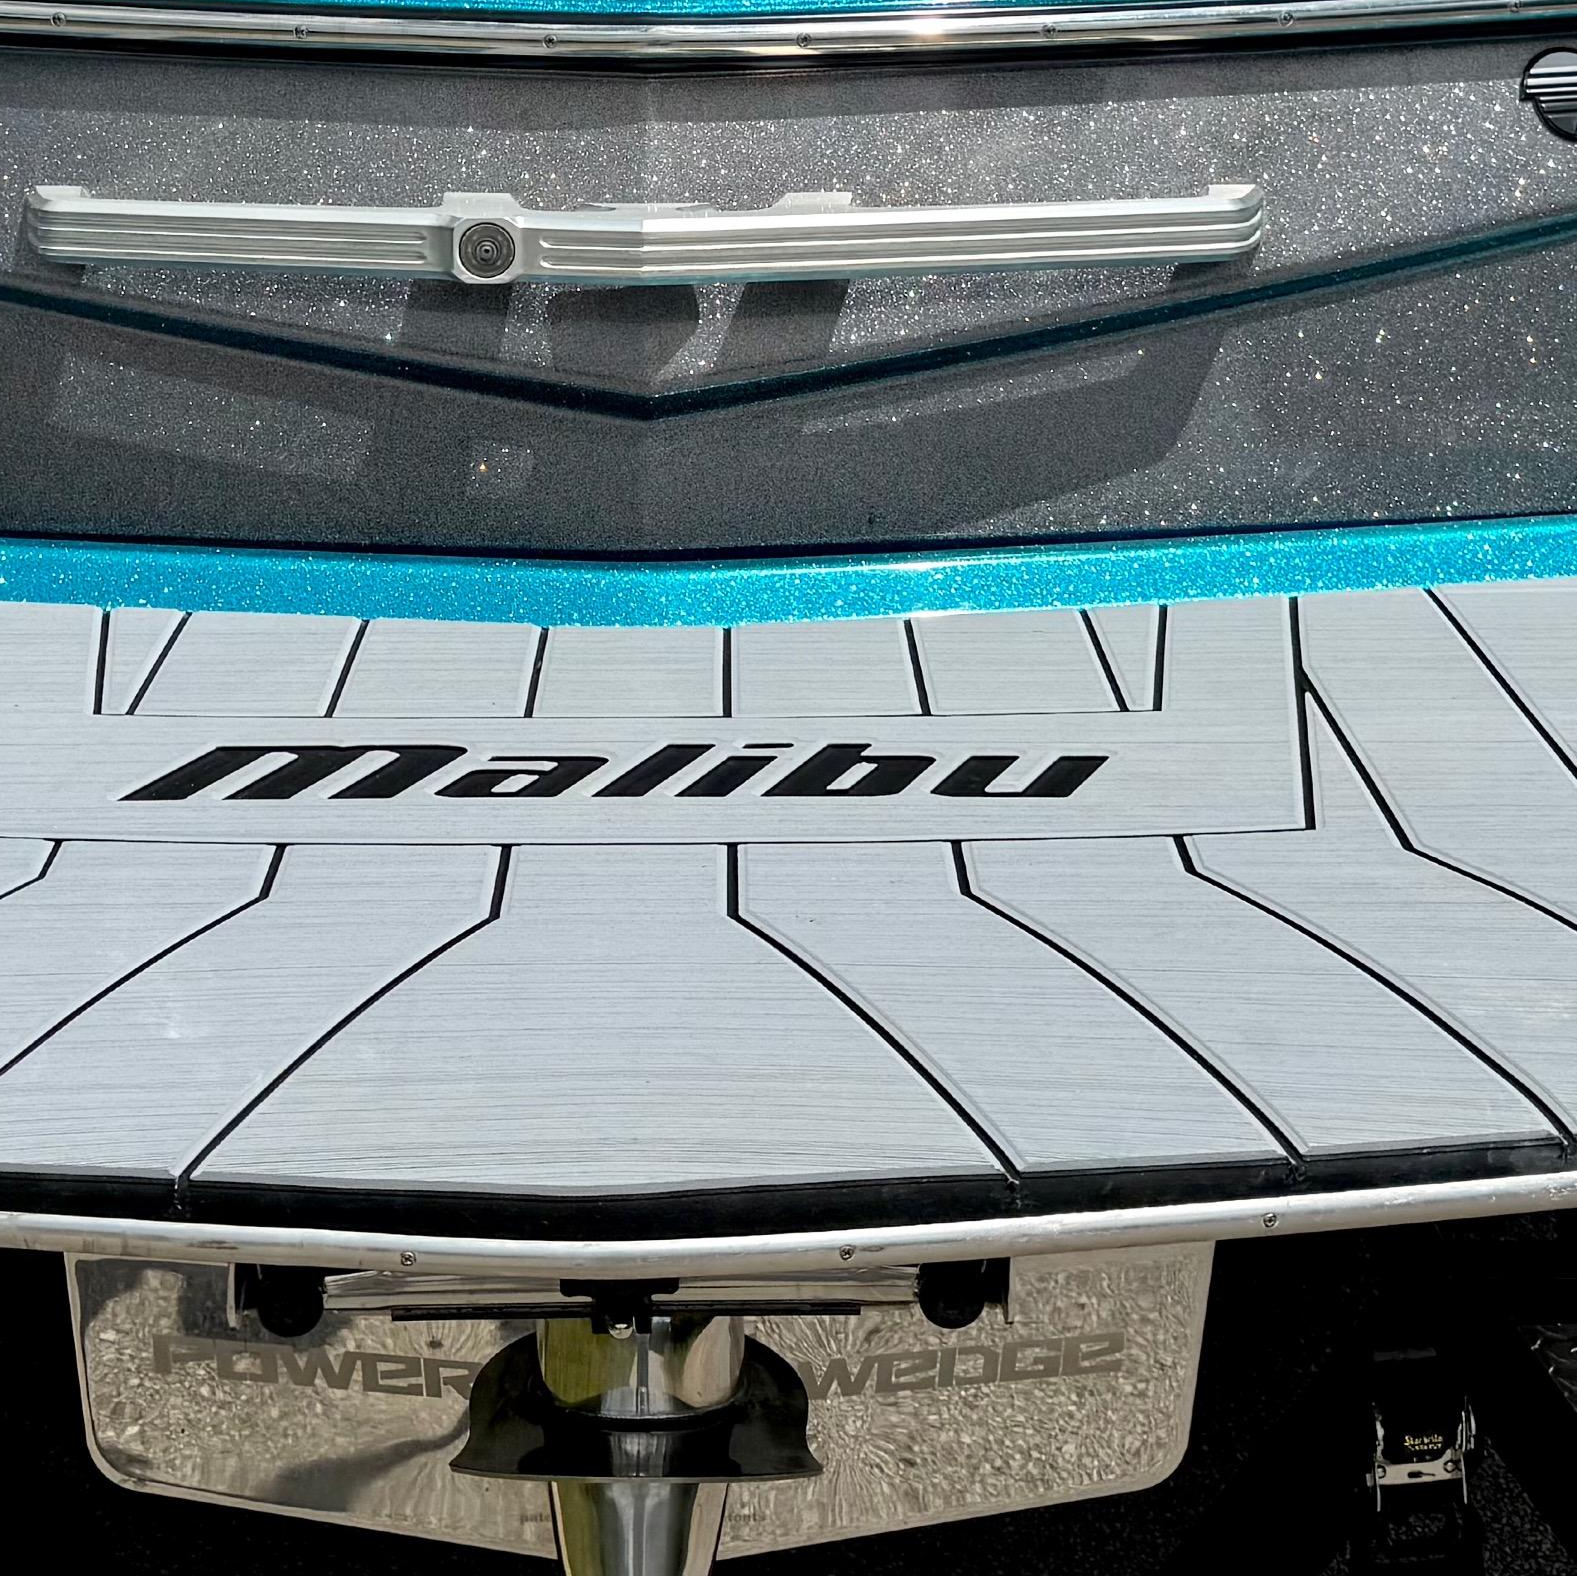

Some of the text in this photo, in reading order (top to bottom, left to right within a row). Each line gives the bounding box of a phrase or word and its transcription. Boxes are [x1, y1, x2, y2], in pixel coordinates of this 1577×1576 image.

[115, 739, 1111, 802] Malibu
[152, 1330, 1125, 1401] POWER WEDGE
